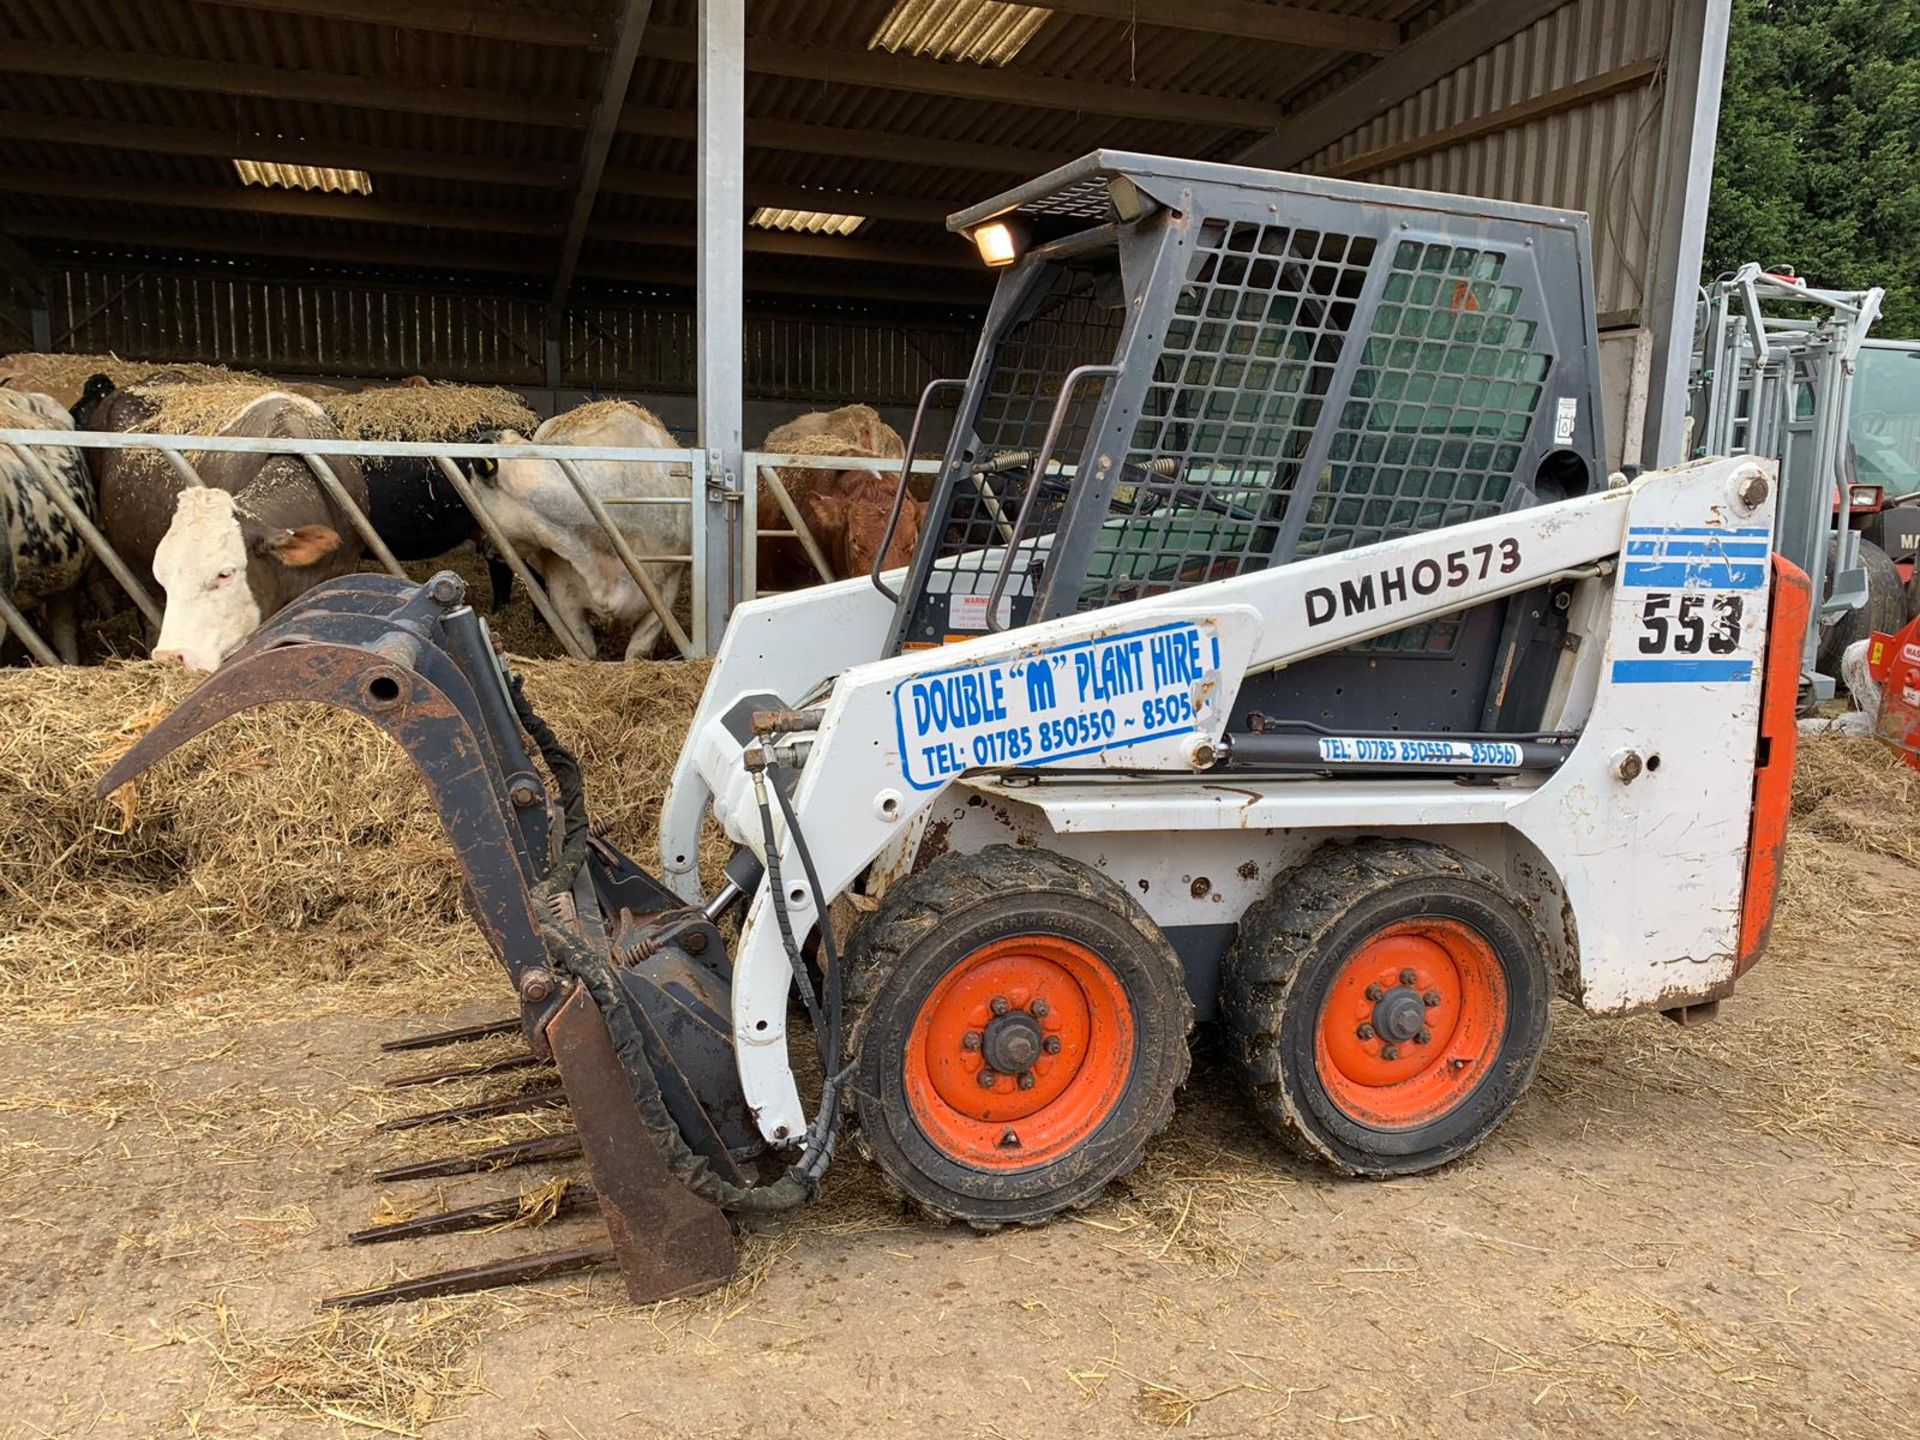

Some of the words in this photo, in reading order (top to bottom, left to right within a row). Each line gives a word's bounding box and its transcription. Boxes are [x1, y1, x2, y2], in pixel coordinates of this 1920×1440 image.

[1638, 593, 1744, 655] 553
[912, 668, 1007, 737] DOUBLE
[1075, 640, 1144, 704] PLANT
[1150, 629, 1203, 694] HIRE
[922, 743, 967, 776] TEL:
[973, 726, 1032, 765] 01785
[1039, 709, 1116, 752] 850550
[1321, 739, 1351, 760] TEL:
[1355, 740, 1397, 761] 01785
[1469, 742, 1518, 765] 850561
